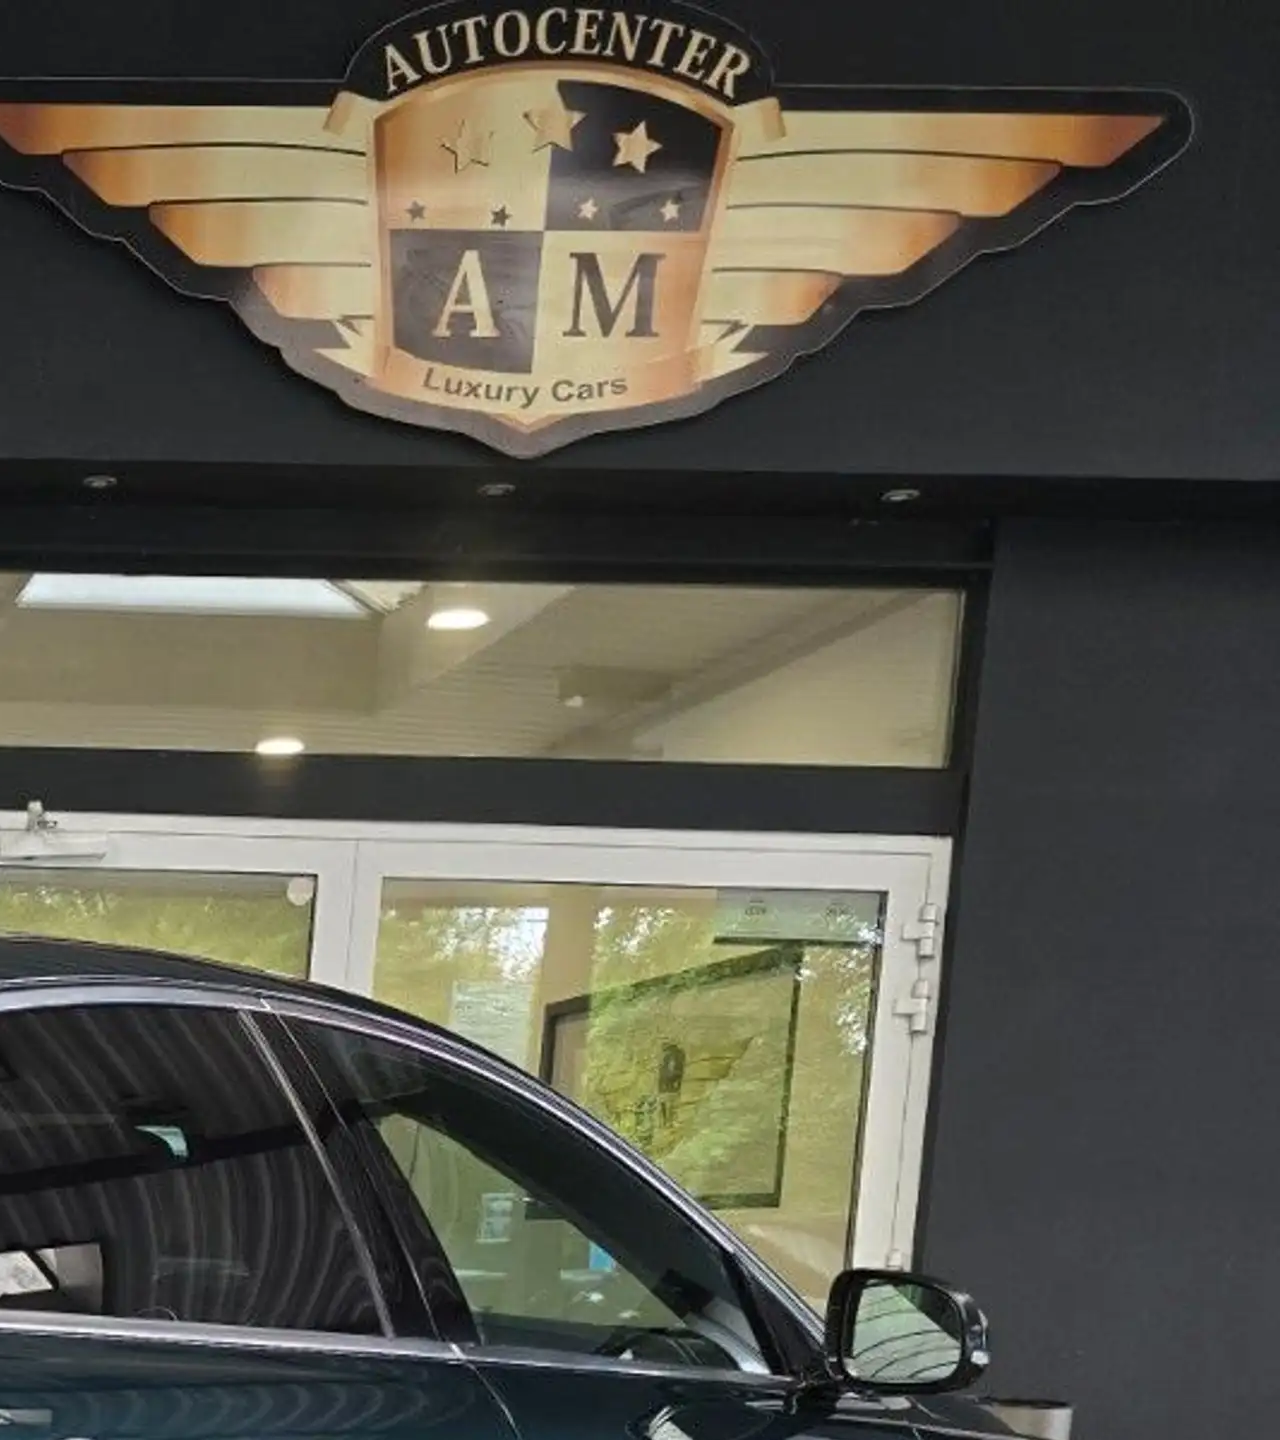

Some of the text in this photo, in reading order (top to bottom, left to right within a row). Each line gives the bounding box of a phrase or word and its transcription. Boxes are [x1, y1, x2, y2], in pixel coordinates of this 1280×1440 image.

[384, 7, 751, 99] AUTOCENTER
[431, 248, 667, 339] A M
[422, 366, 629, 408] Luxury Cars
